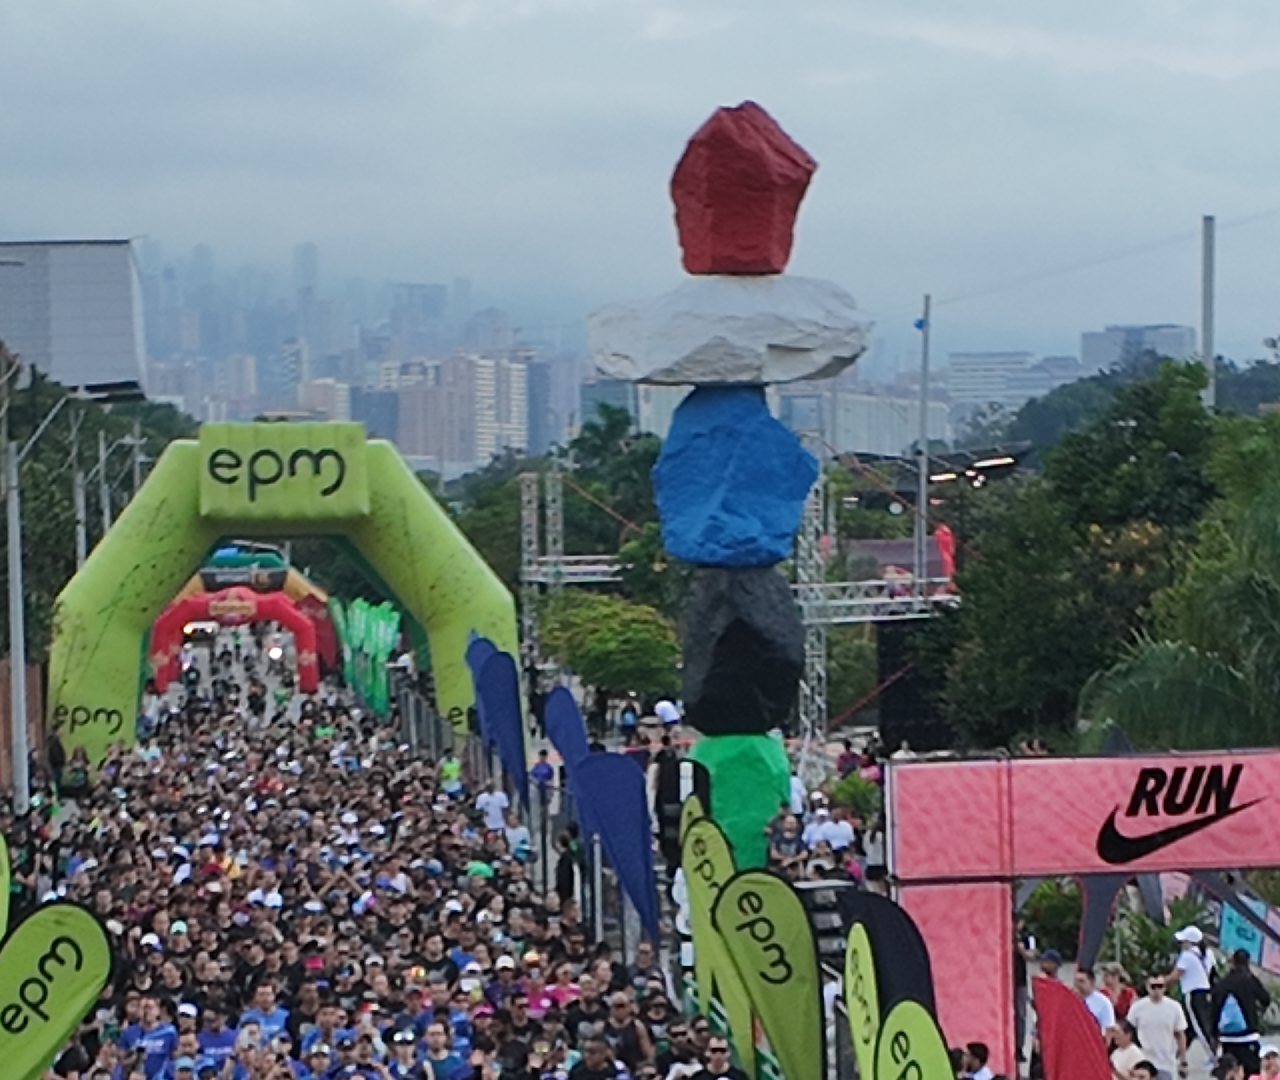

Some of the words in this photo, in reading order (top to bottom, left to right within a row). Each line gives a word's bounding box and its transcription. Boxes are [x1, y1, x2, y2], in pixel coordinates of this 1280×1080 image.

[208, 448, 346, 502] epm
[53, 703, 123, 735] epm
[1126, 764, 1243, 817] RUN
[735, 891, 793, 984] epm
[0, 935, 83, 1034] epm
